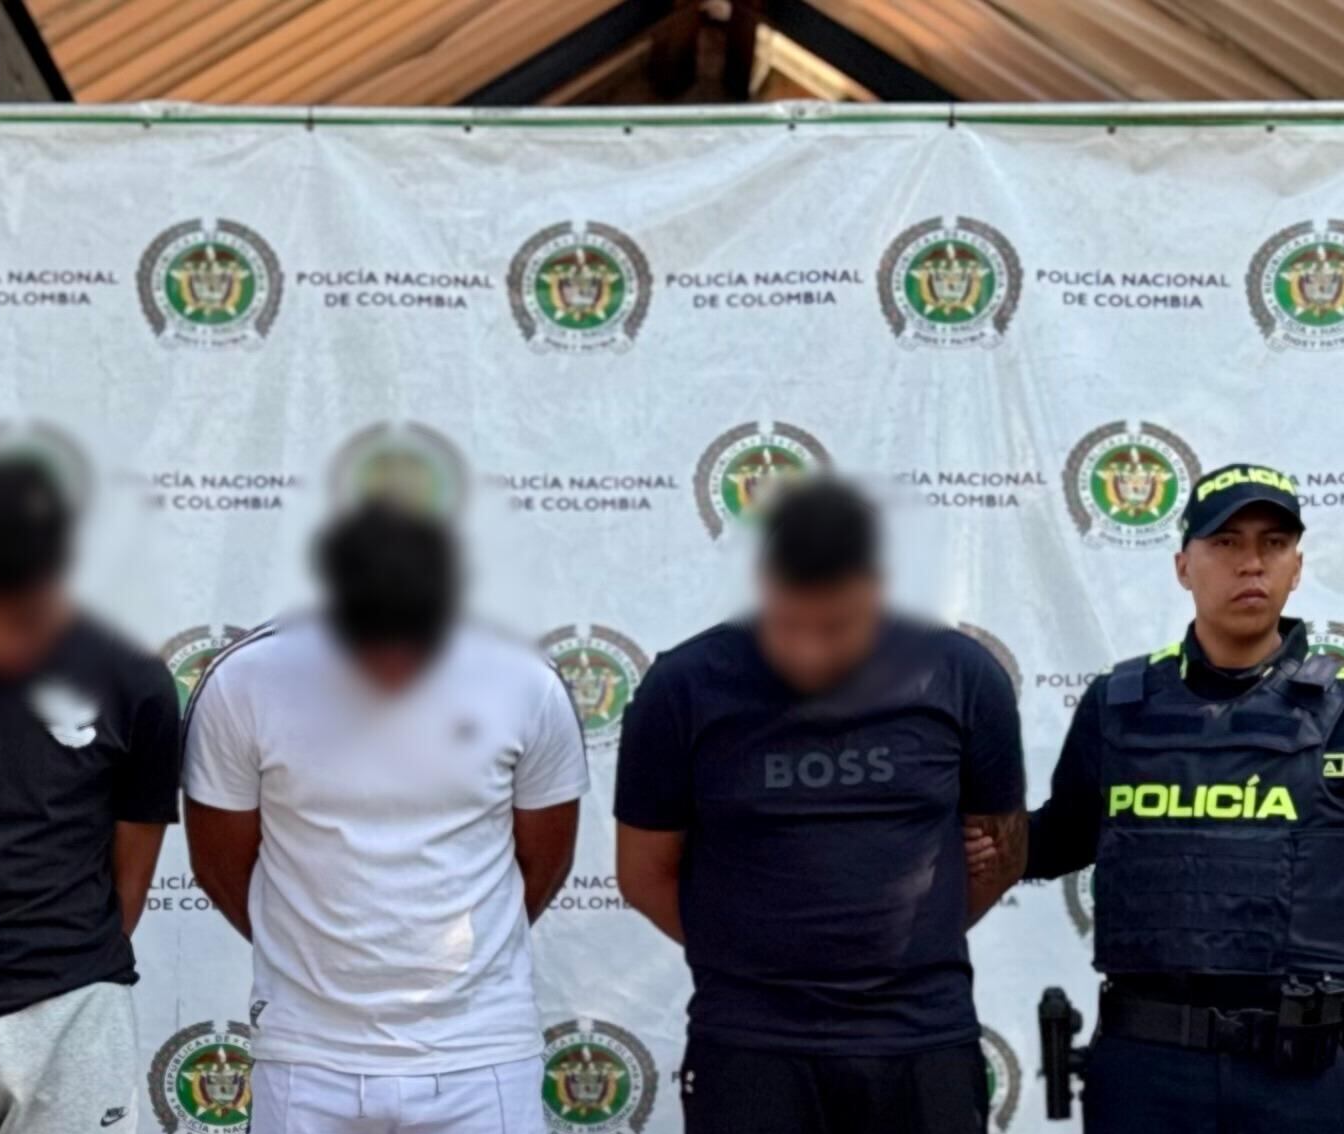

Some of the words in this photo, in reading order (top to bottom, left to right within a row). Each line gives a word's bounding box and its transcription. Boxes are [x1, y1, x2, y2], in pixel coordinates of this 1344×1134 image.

[7, 270, 118, 285] NACIONAL
[295, 267, 379, 287] POLICÍA
[384, 272, 494, 289] NACIONAL
[665, 269, 749, 289] POLICÍA
[754, 269, 863, 286] NACIONAL
[1035, 266, 1116, 287] POLICÍA
[1121, 273, 1229, 288] NACIONAL
[324, 292, 350, 308] DE
[356, 291, 468, 309] COLOMBIA
[692, 293, 719, 309] DE
[725, 290, 837, 308] COLOMBIA
[1062, 291, 1087, 307] DE
[1093, 293, 1203, 309] COLOMBIA
[568, 475, 678, 491] NACIONAL
[937, 470, 1047, 487] NACIONAL
[172, 495, 283, 510] COLOMBIA
[540, 496, 652, 512] COLOMBIA
[926, 492, 1020, 509] OLOMBIA
[1035, 672, 1097, 689] POLIC
[764, 746, 895, 789] BOSS
[1109, 775, 1298, 820] POLICÍA
[147, 896, 174, 911] DE
